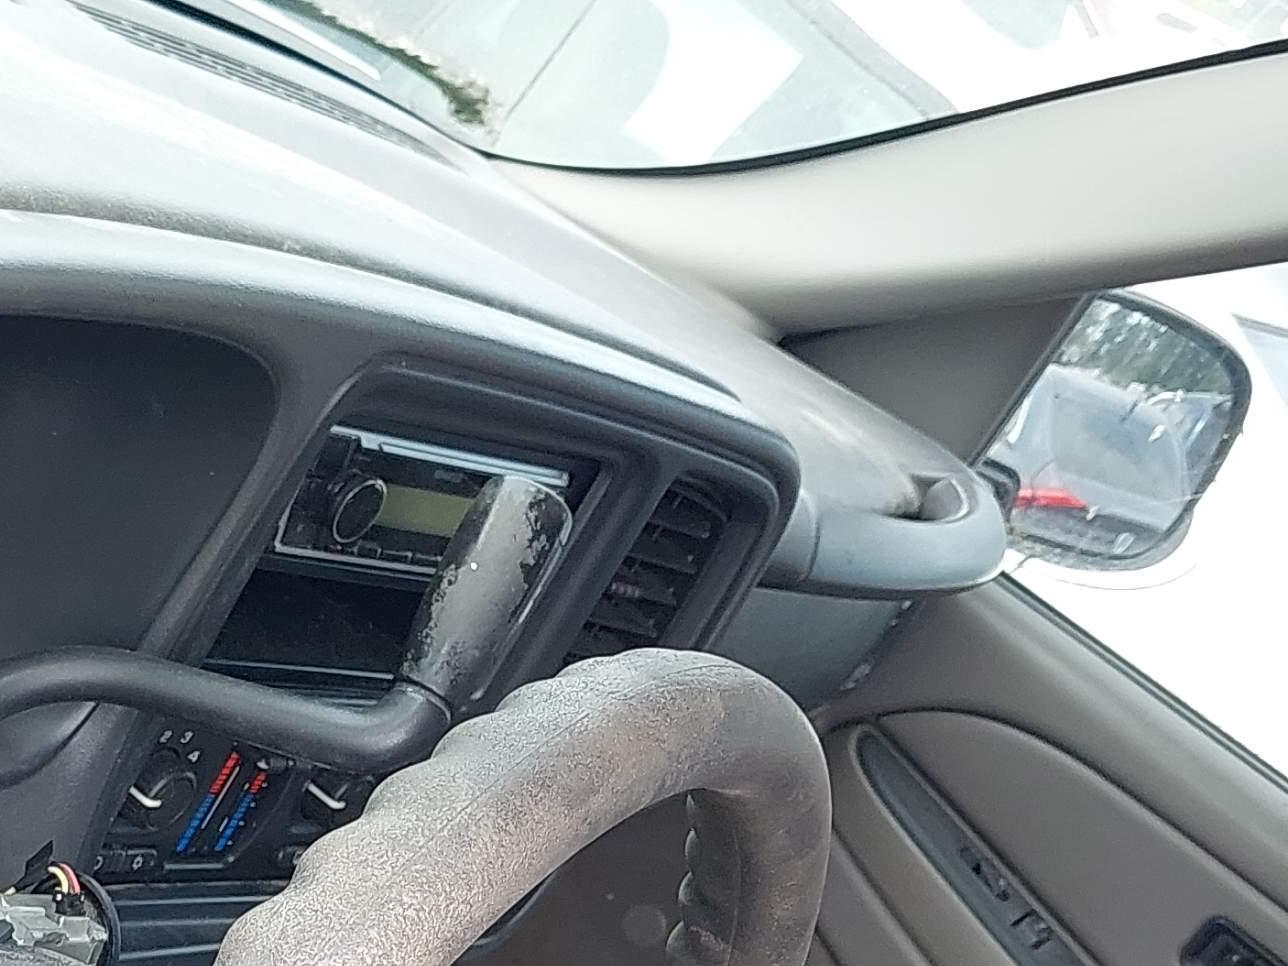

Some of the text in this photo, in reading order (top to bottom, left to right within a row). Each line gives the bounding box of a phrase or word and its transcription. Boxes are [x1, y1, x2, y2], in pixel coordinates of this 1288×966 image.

[159, 729, 172, 744] 2
[180, 731, 194, 744] 3
[187, 750, 201, 763] 4
